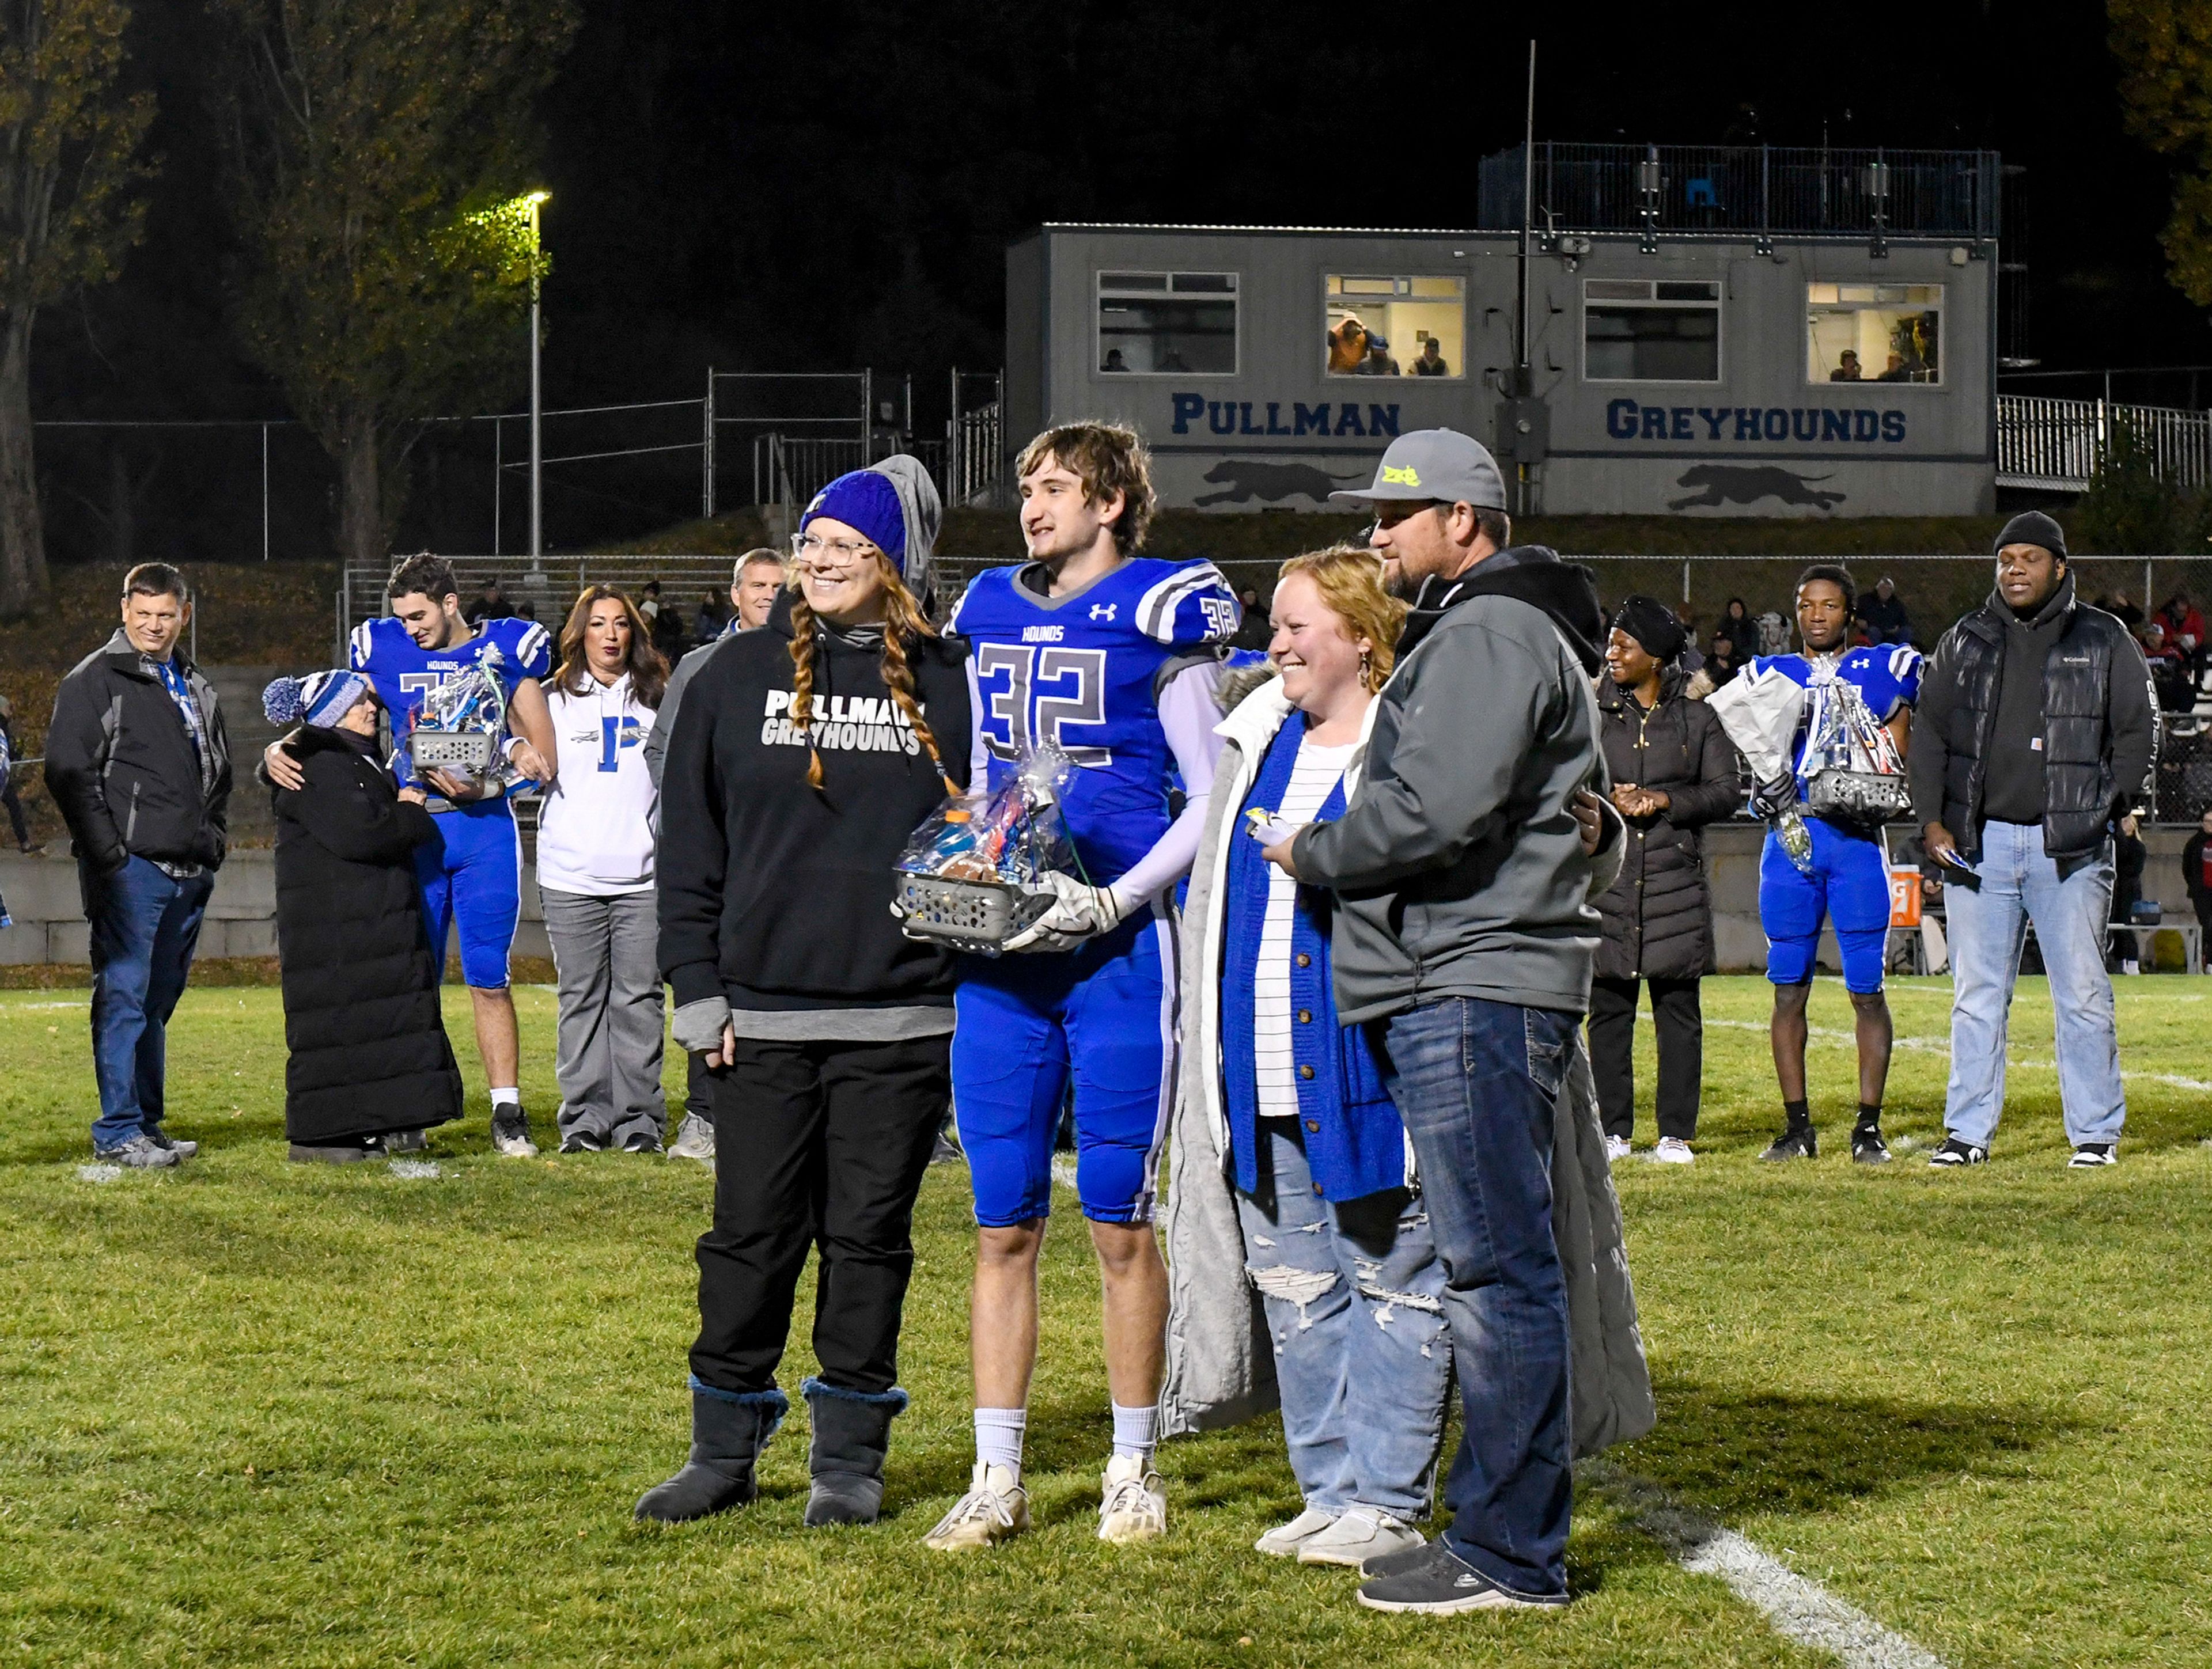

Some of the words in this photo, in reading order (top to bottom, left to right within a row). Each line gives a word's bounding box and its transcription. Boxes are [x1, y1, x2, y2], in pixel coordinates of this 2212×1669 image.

[1172, 393, 1400, 437] PULLMAN
[1607, 398, 1906, 442] GREYHOUNDS
[1021, 625, 1065, 642] HOUNDS
[1199, 597, 1238, 643] 32
[427, 661, 459, 670] HOUNDS
[978, 642, 1112, 768] 32
[761, 718, 920, 756] GREYHOUNDS
